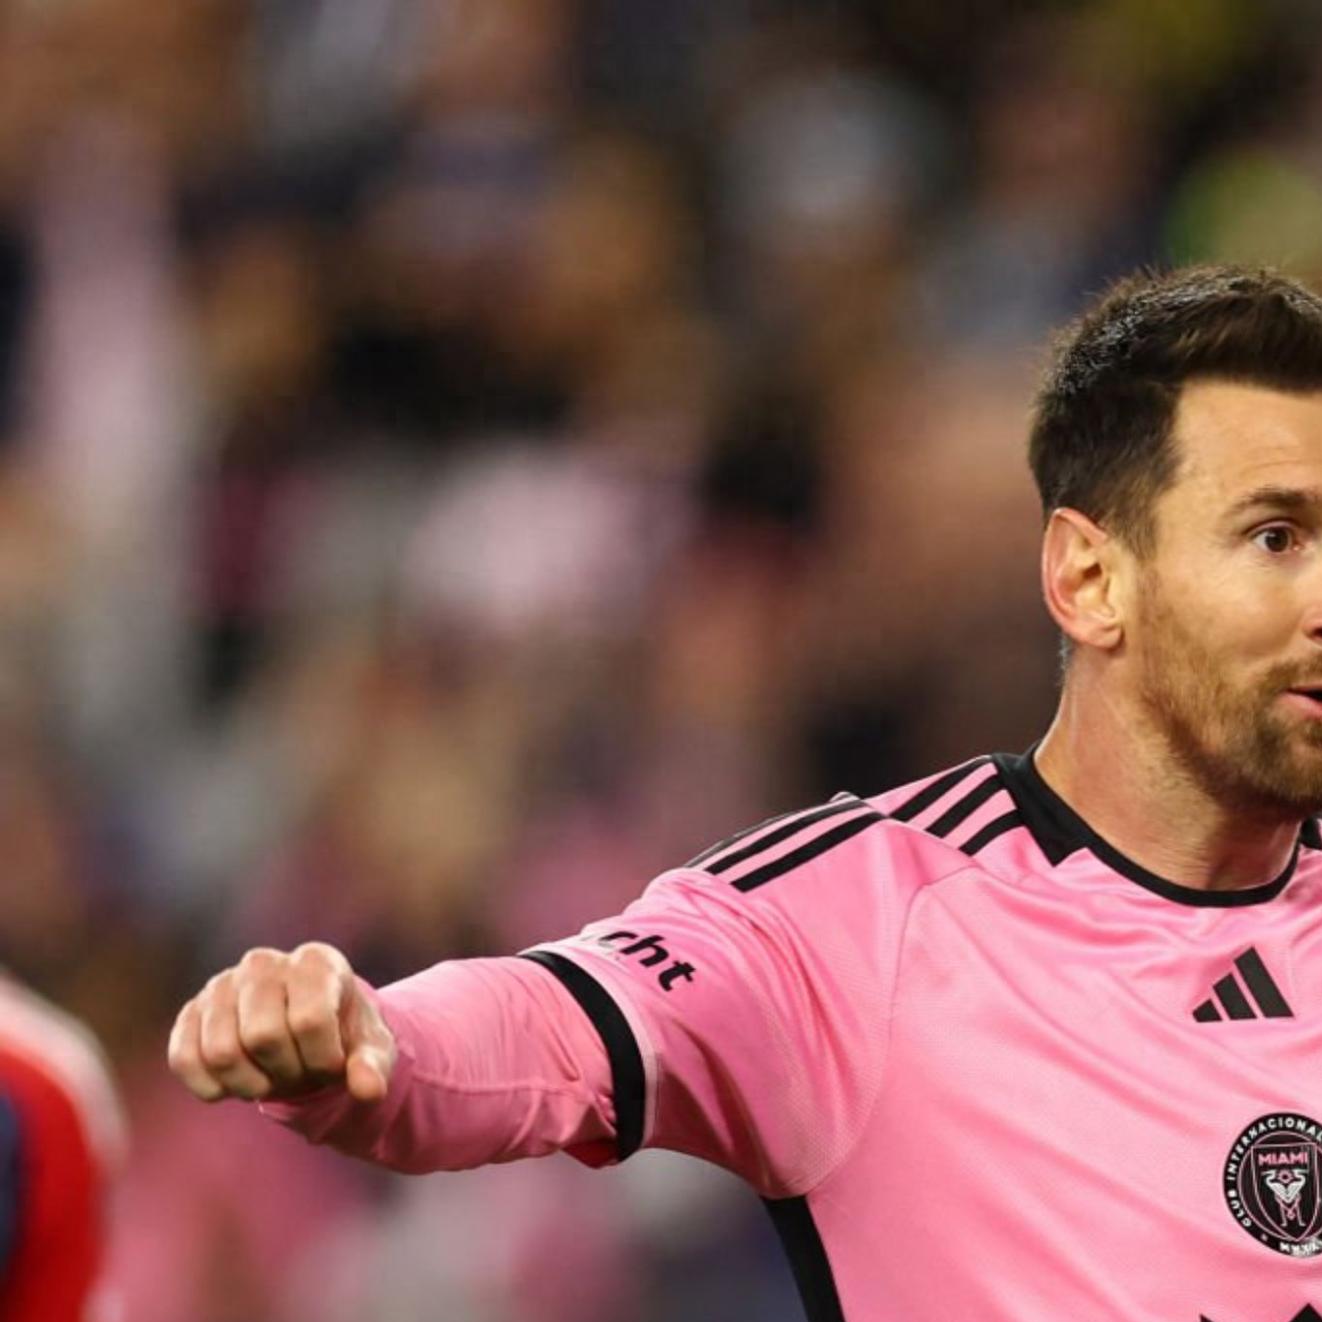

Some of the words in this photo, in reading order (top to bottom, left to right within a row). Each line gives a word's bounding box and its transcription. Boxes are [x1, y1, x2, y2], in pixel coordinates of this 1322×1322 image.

[598, 930, 696, 991] cht
[1227, 1116, 1322, 1181] INTERNACIONAL
[1258, 1151, 1309, 1166] MIAMI
[1227, 1189, 1252, 1228] CLUB
